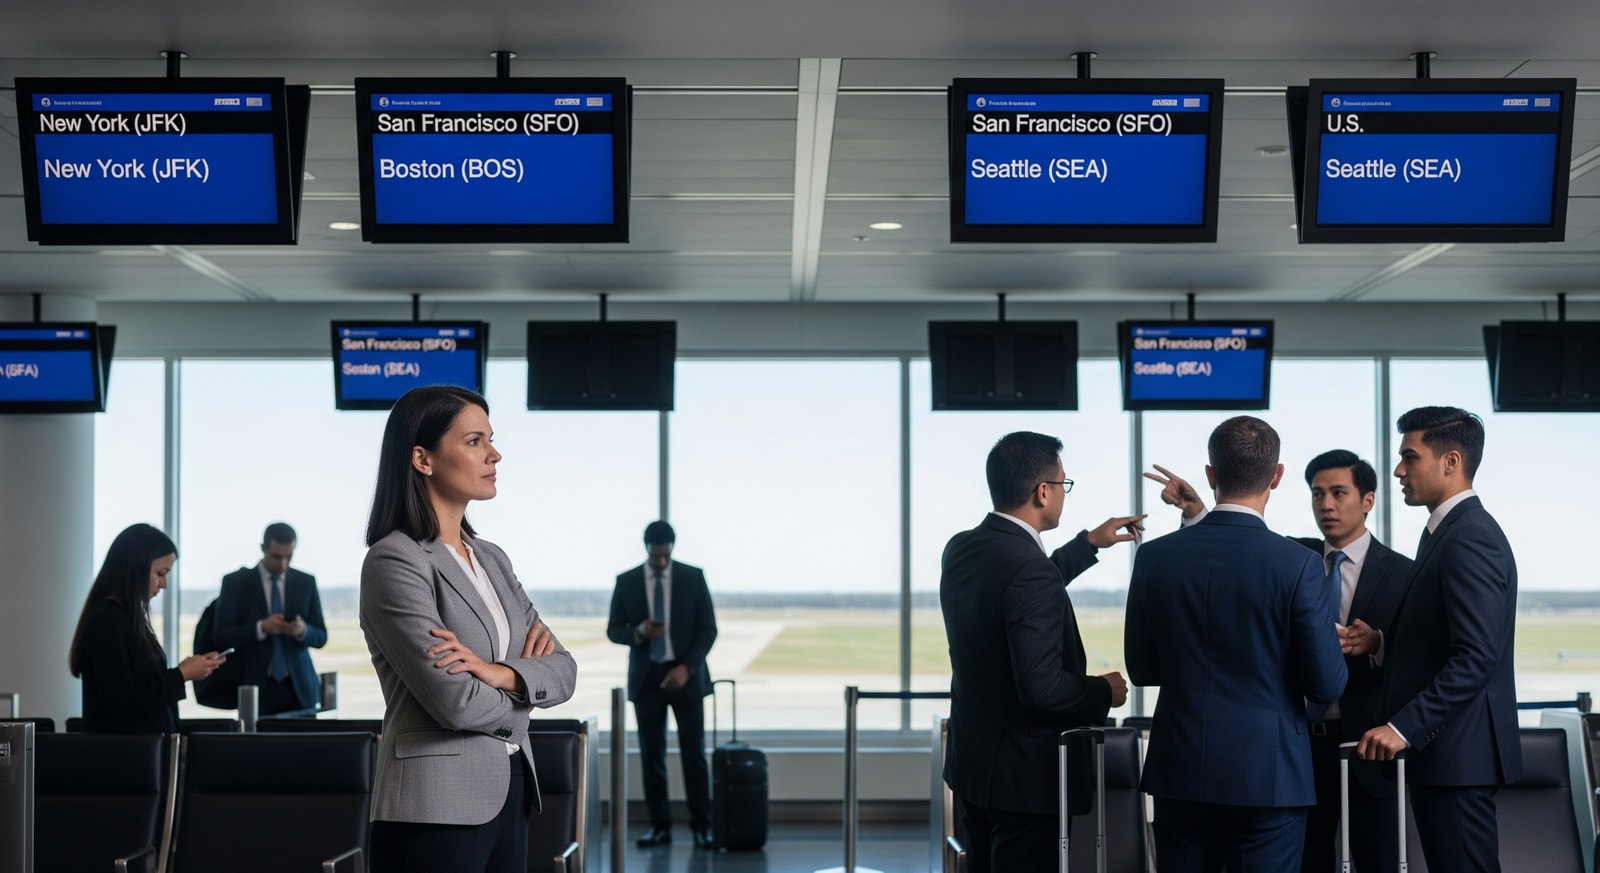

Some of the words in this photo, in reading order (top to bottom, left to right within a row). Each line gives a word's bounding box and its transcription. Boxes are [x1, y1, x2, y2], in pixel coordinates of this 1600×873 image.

[40, 114, 81, 131] New
[86, 114, 129, 132] York
[135, 113, 186, 136] (JFK)
[378, 114, 415, 132] San
[422, 113, 517, 132] Francisco
[524, 113, 578, 136] (SFO)
[973, 114, 1009, 132] San
[1017, 114, 1110, 132] Francisco
[1117, 114, 1171, 136] (SFO)
[1328, 114, 1363, 132] U.S.
[45, 159, 91, 178] New
[97, 159, 146, 178] York
[153, 159, 209, 183] (JFK)
[380, 159, 454, 178] Boston
[462, 159, 523, 183] (BOS)
[972, 159, 1041, 178] Seattle
[1049, 159, 1107, 183] (SEA)
[1326, 159, 1396, 178] Seattle
[1403, 159, 1460, 182] (SEA)
